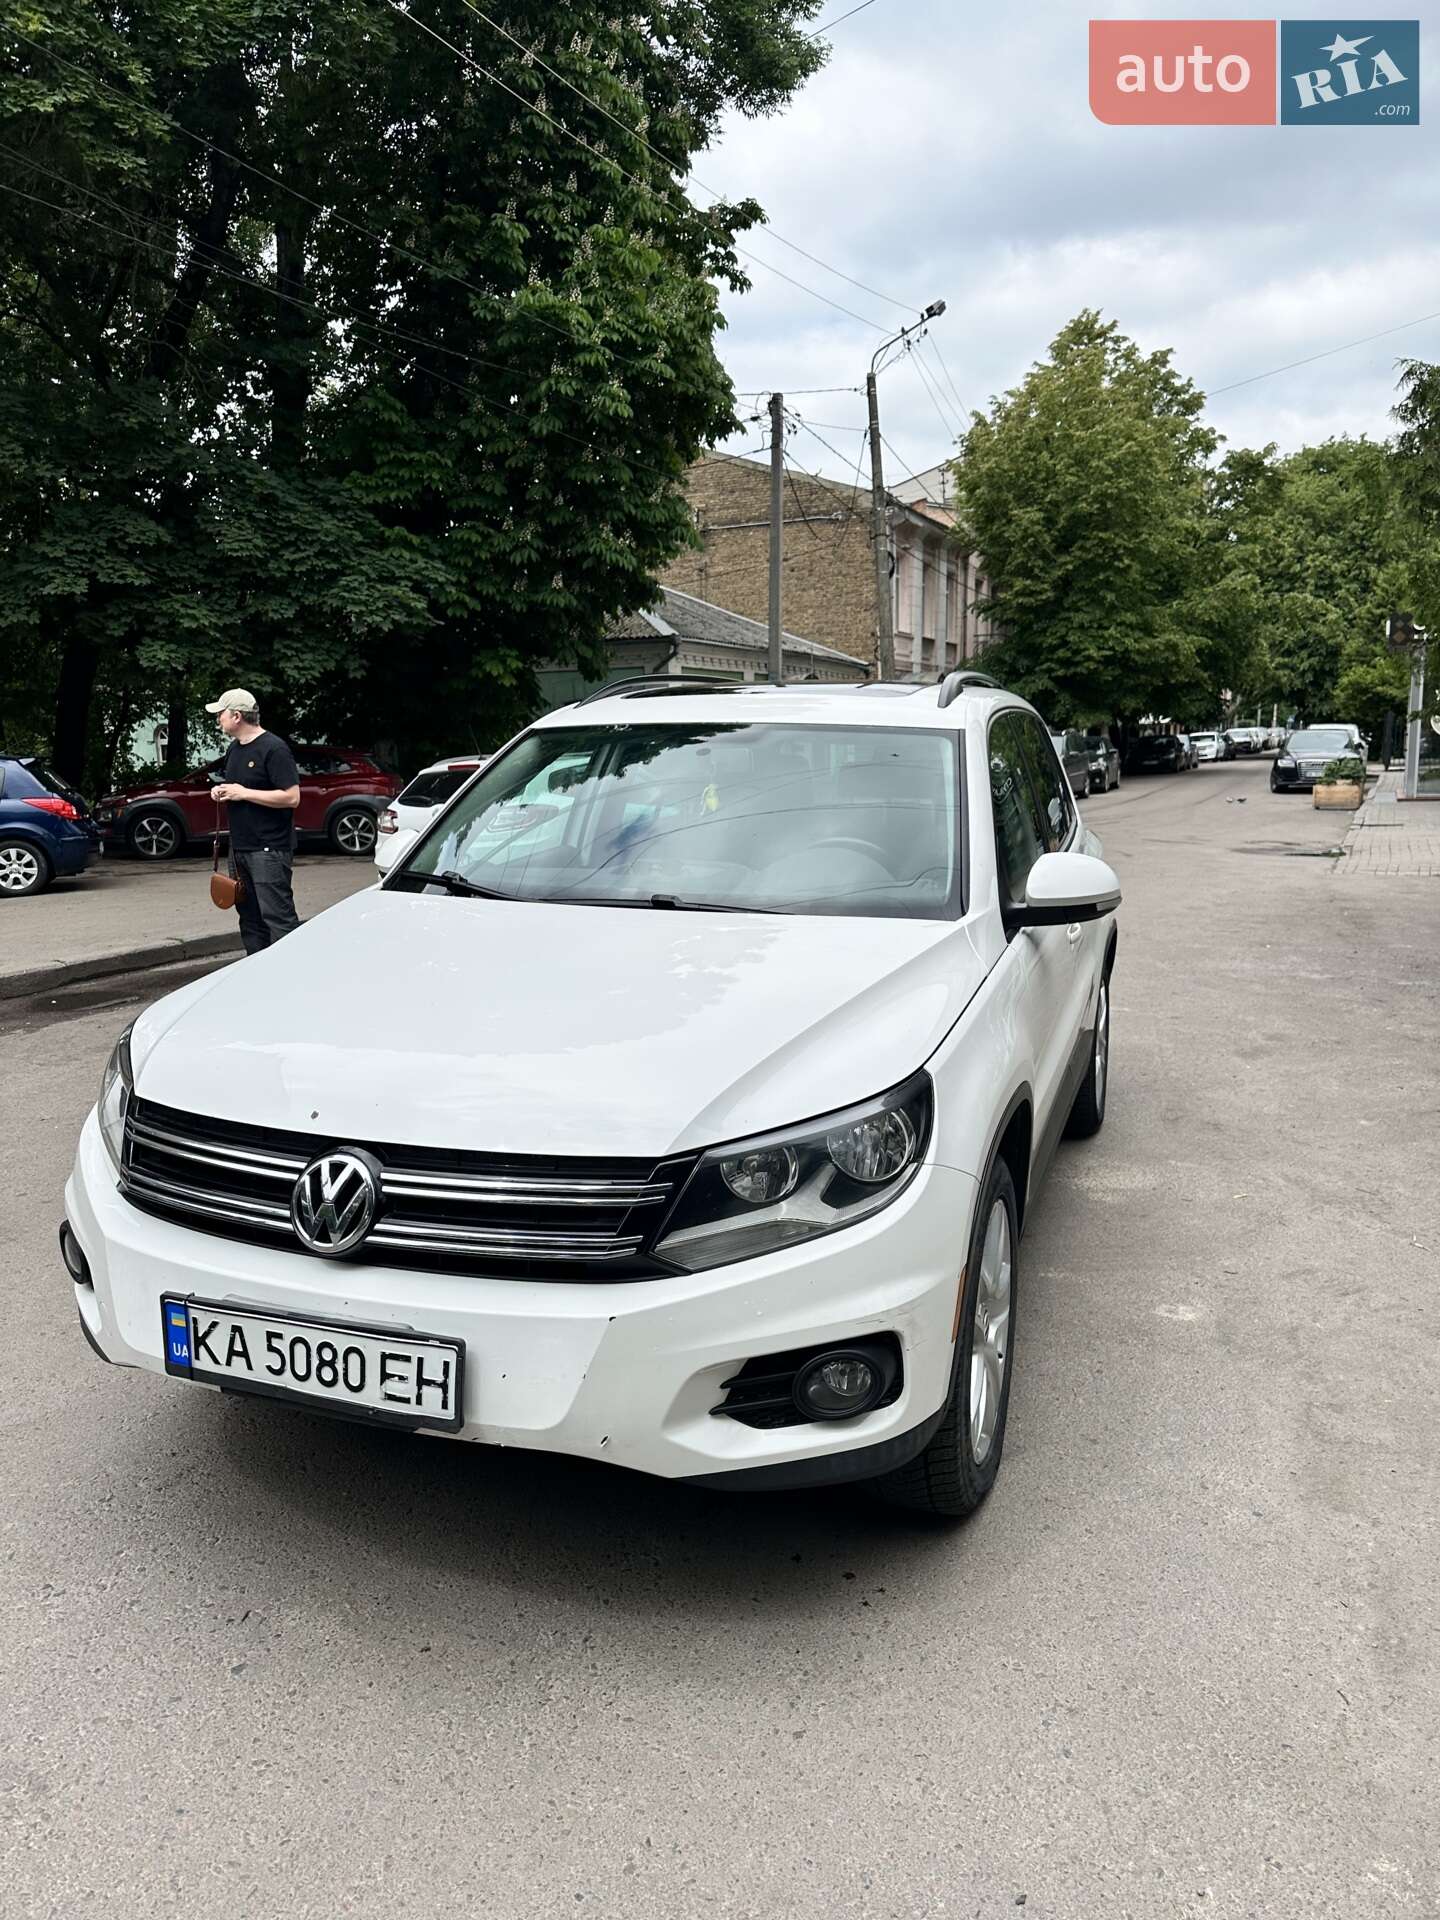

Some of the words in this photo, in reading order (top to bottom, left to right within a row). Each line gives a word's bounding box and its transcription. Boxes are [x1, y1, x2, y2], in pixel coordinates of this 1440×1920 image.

[296, 1156, 371, 1248] VW
[172, 1341, 189, 1358] UA
[192, 1316, 254, 1371] KA
[265, 1330, 366, 1393] 5080
[380, 1351, 451, 1410] EH
